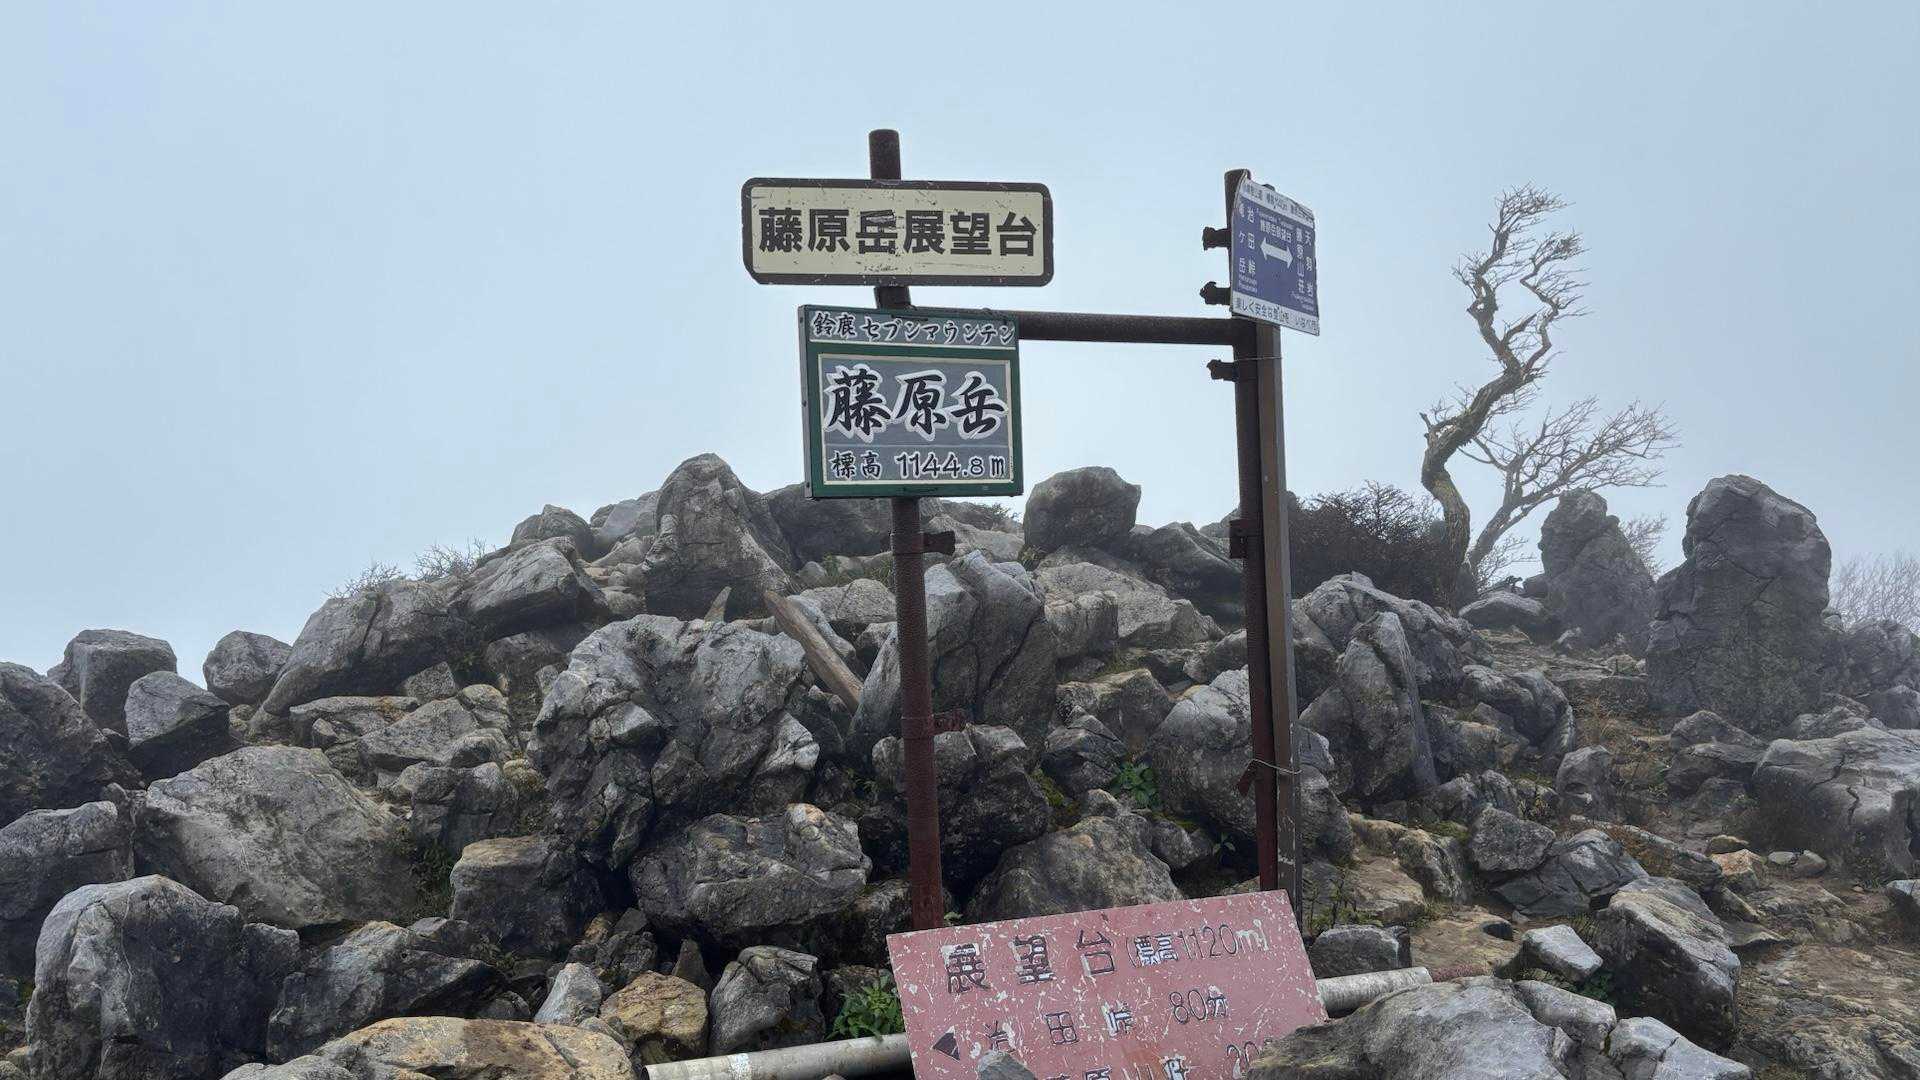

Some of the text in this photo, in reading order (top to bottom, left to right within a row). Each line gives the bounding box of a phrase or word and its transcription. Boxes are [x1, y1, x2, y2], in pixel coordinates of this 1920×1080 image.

[758, 207, 1038, 257] 藤原岳展望台
[824, 363, 1008, 443] 藤原岳
